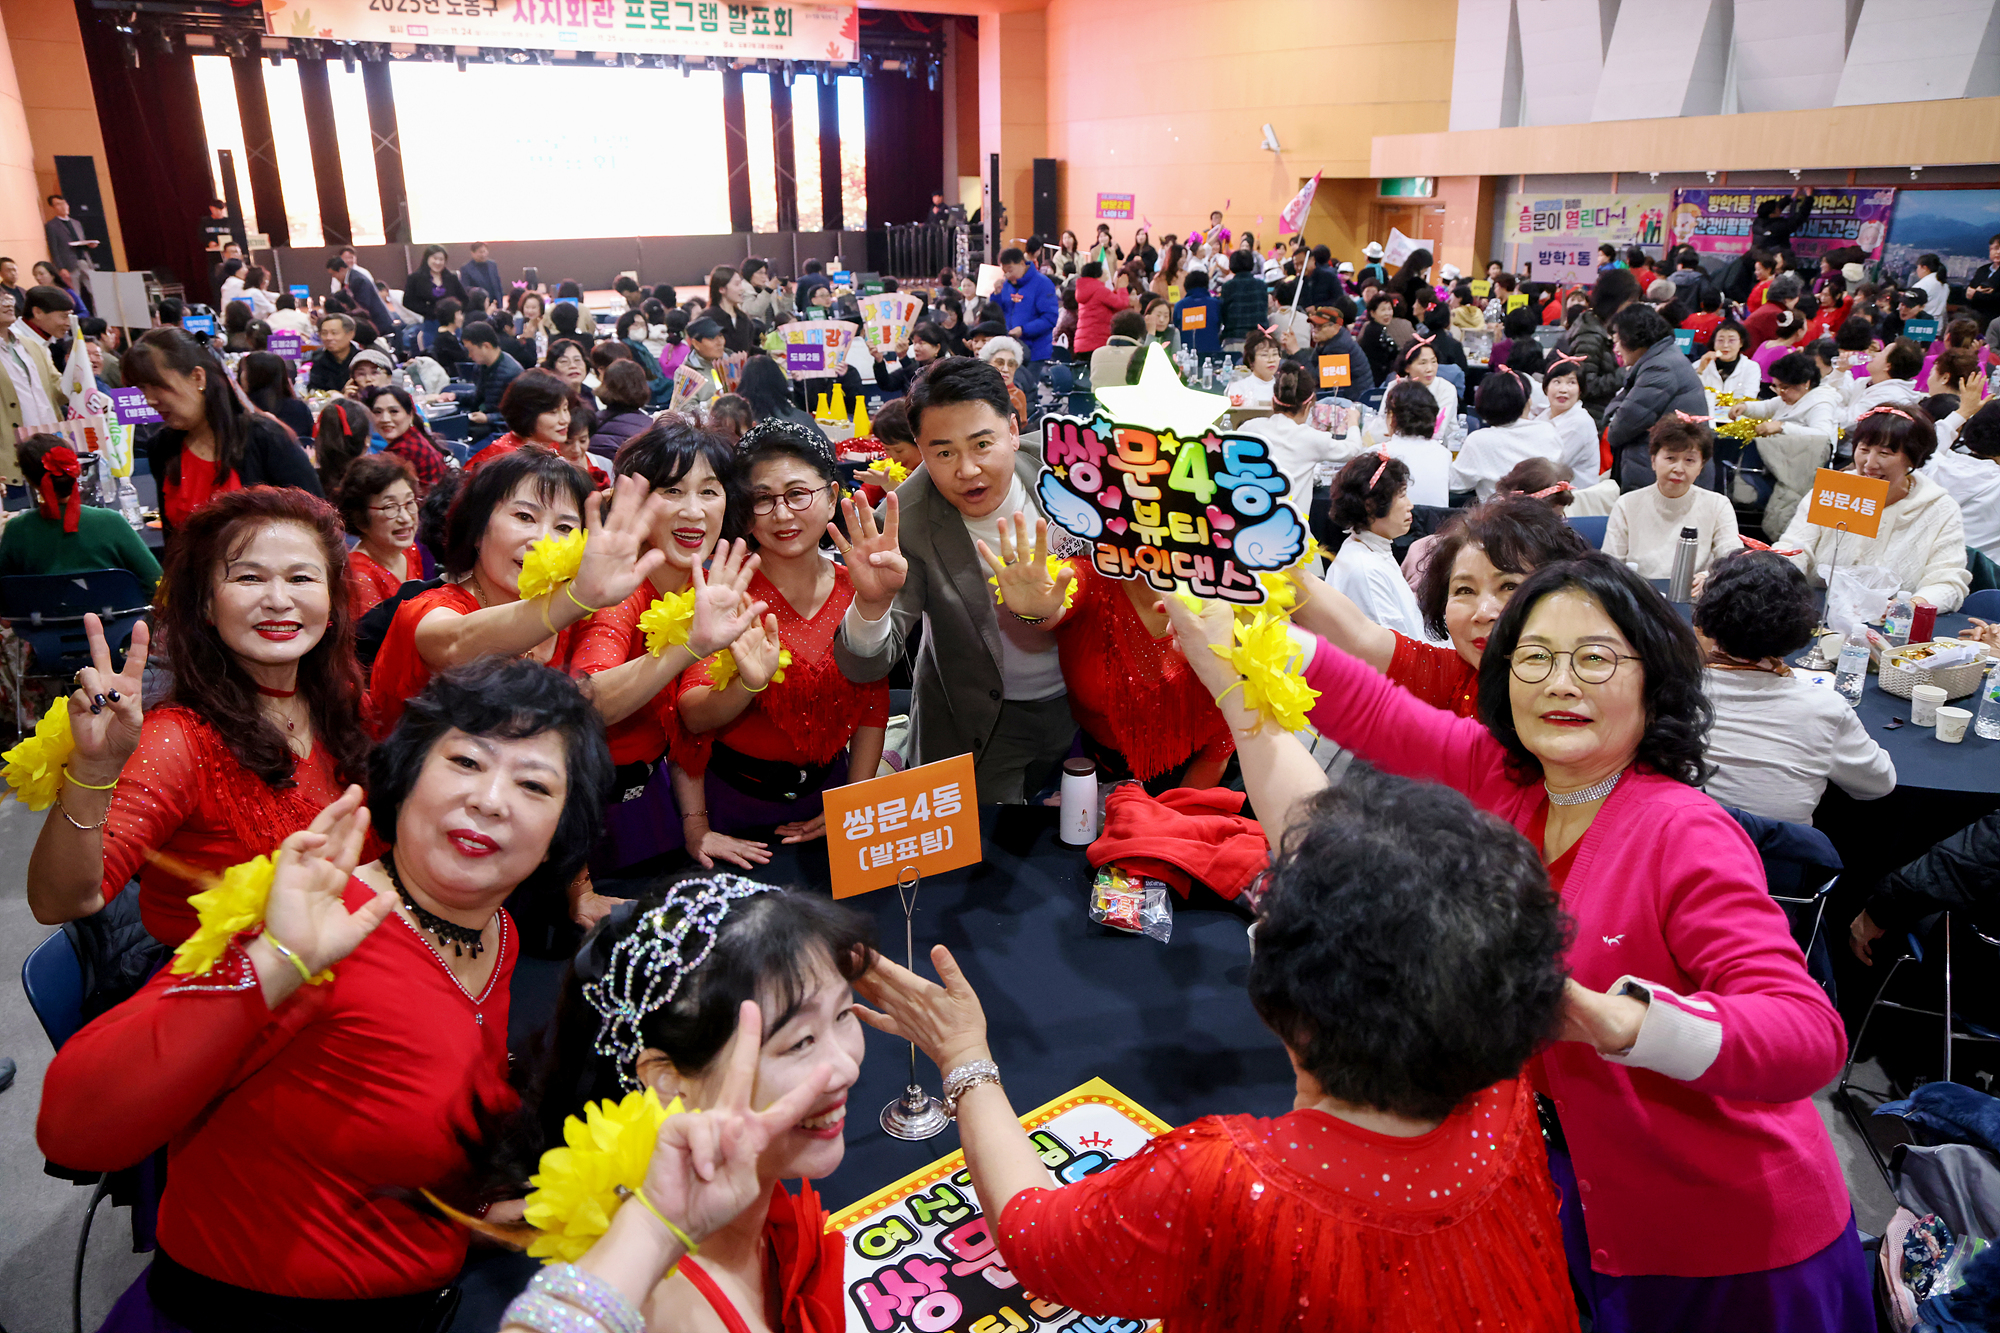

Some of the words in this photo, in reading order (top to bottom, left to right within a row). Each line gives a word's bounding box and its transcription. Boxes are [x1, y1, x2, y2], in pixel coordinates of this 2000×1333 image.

[625, 0, 718, 32] 프로그램
[728, 4, 793, 37] 발표회
[1707, 195, 1752, 213] 방학1동
[1796, 194, 1857, 215] 인댄스!
[1519, 206, 1561, 233] 흥문이
[1565, 206, 1627, 230] 열린다~!
[1790, 218, 1861, 240] 0세고고씽
[1539, 250, 1592, 267] 방학1동
[1184, 312, 1205, 323] 쌍문4동
[790, 352, 821, 363] 도봉2동
[1322, 365, 1348, 377] 쌍문4동
[118, 394, 148, 407] 도봉2
[1046, 421, 1287, 517] 쌍문4동
[1818, 489, 1877, 517] 쌍문4동
[1129, 499, 1210, 547] 뷰티
[1096, 541, 1262, 601] 라인댄스
[842, 782, 963, 841] 쌍문4동
[858, 825, 955, 871] (발표팀)
